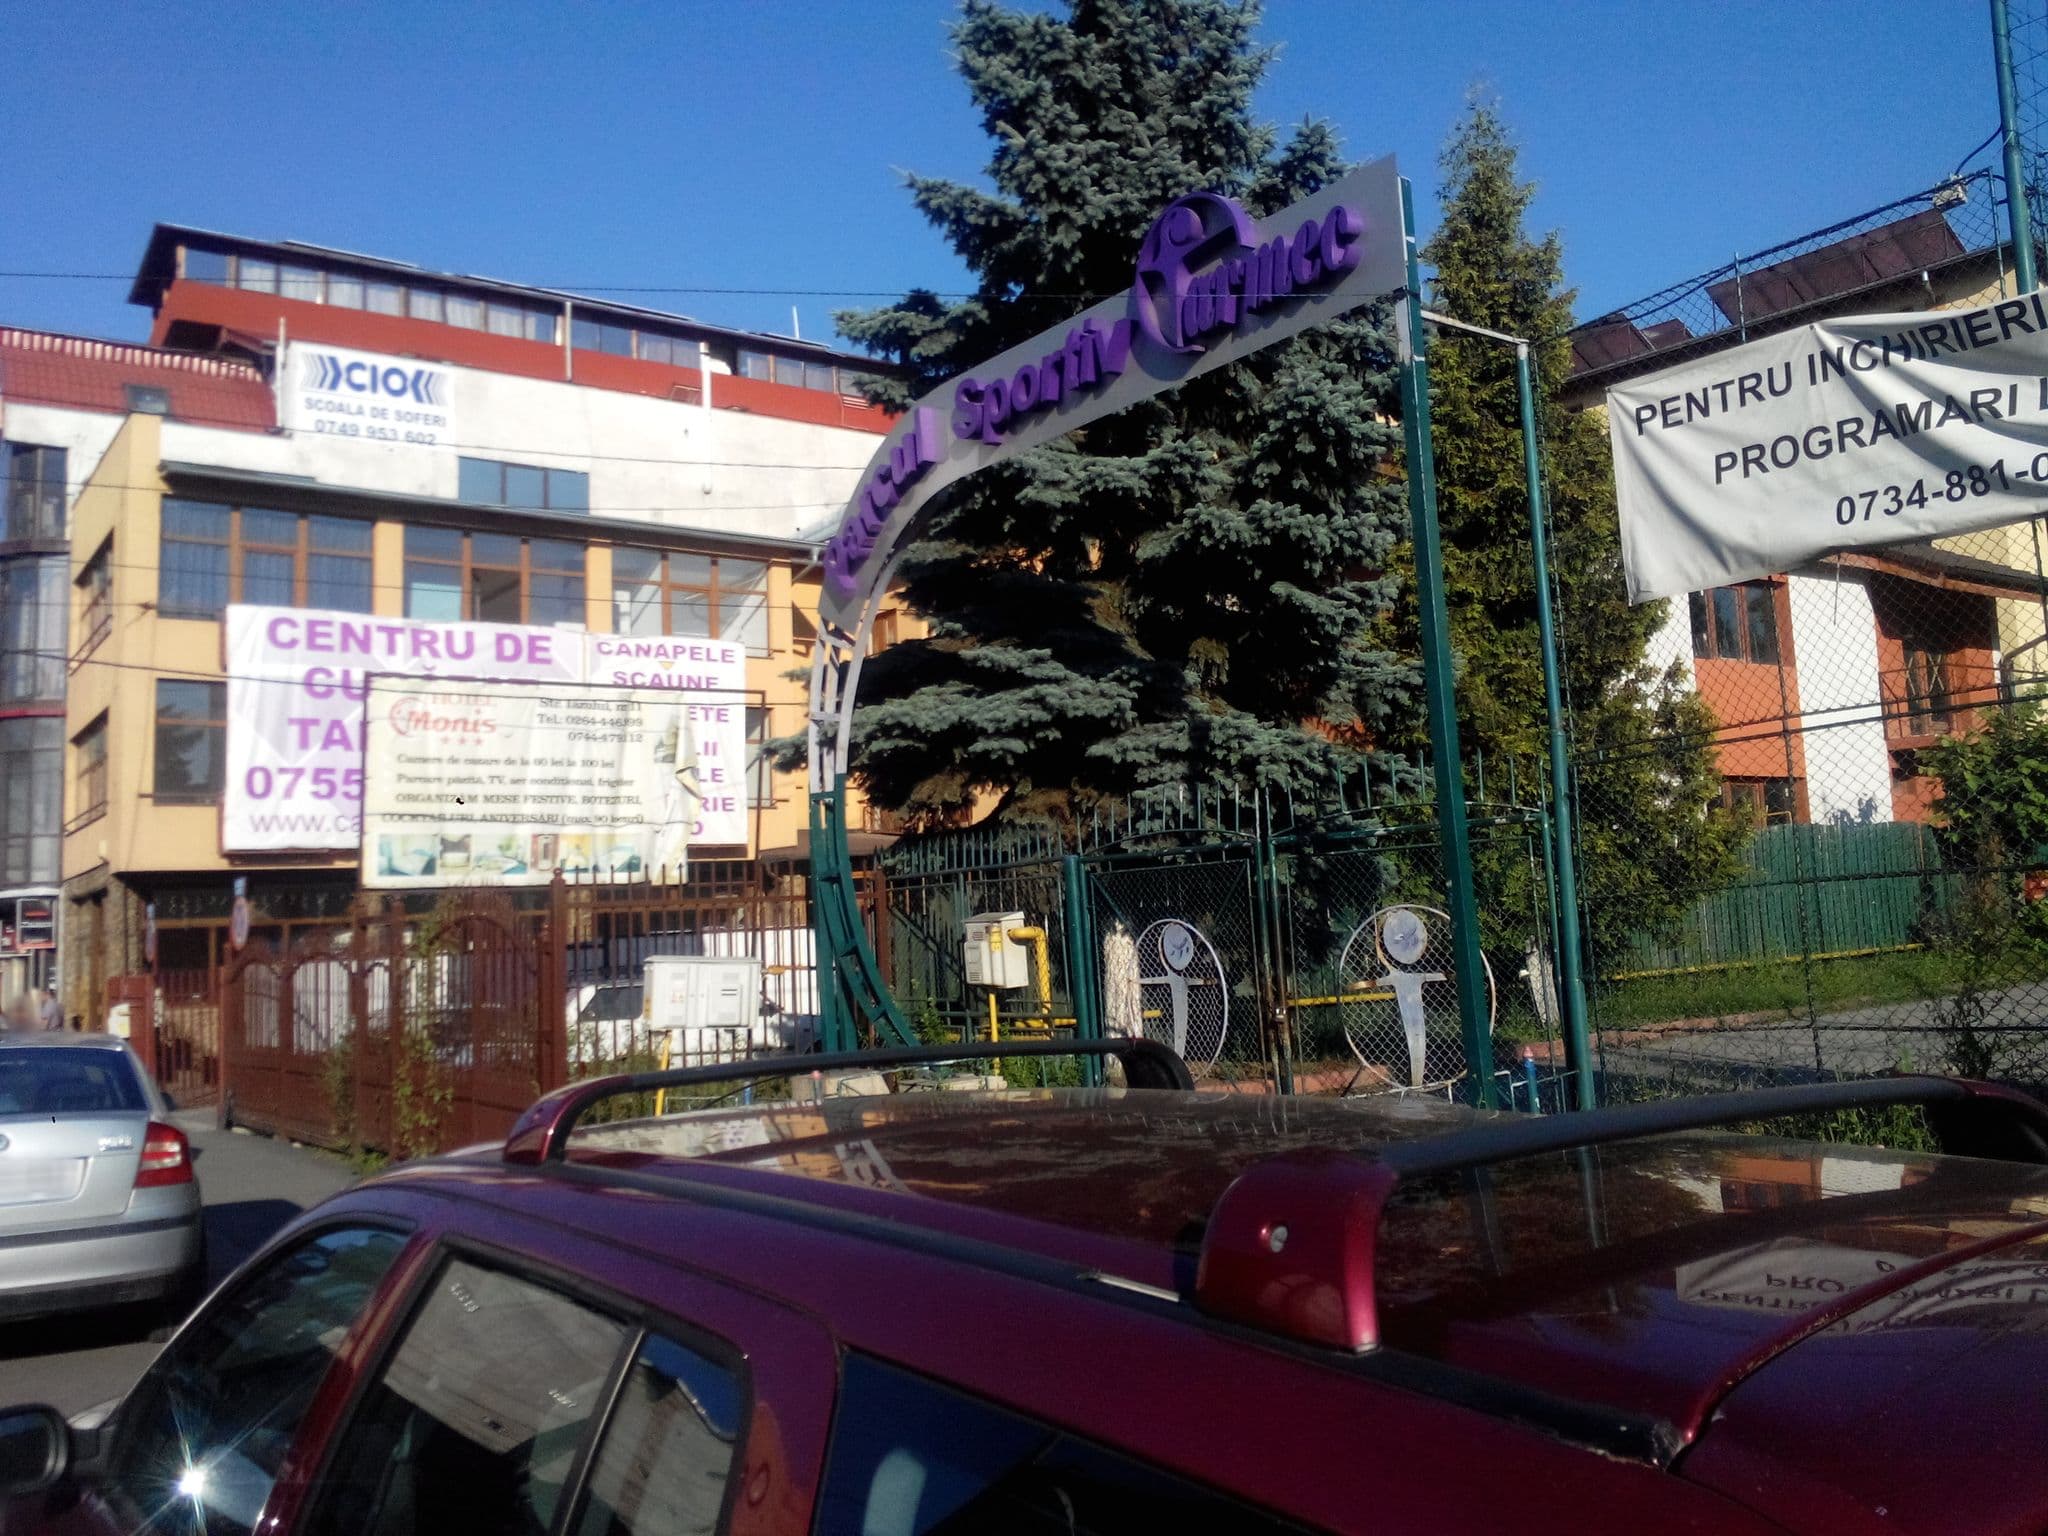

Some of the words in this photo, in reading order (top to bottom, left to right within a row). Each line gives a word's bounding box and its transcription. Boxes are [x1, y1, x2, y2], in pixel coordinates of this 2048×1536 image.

[952, 316, 1138, 446] Sportiv
[1136, 191, 1365, 354] Farmec
[345, 361, 409, 398] CIO
[1634, 361, 1793, 436] PENTRU
[1808, 292, 2048, 387] INCHIRIERI
[304, 397, 366, 417] SCOALA
[370, 406, 389, 421] DE
[394, 409, 447, 428] SOFERI
[314, 418, 360, 437] 0749
[366, 425, 399, 442] 953
[405, 430, 437, 446] 602
[1714, 384, 2018, 485] PROGRAMARI
[266, 616, 475, 661] CENTRU
[493, 632, 553, 666] DE
[597, 641, 737, 664] CANAPELE
[612, 671, 719, 690] SCAUNE
[406, 708, 498, 735] Monis
[482, 793, 520, 804] MESE
